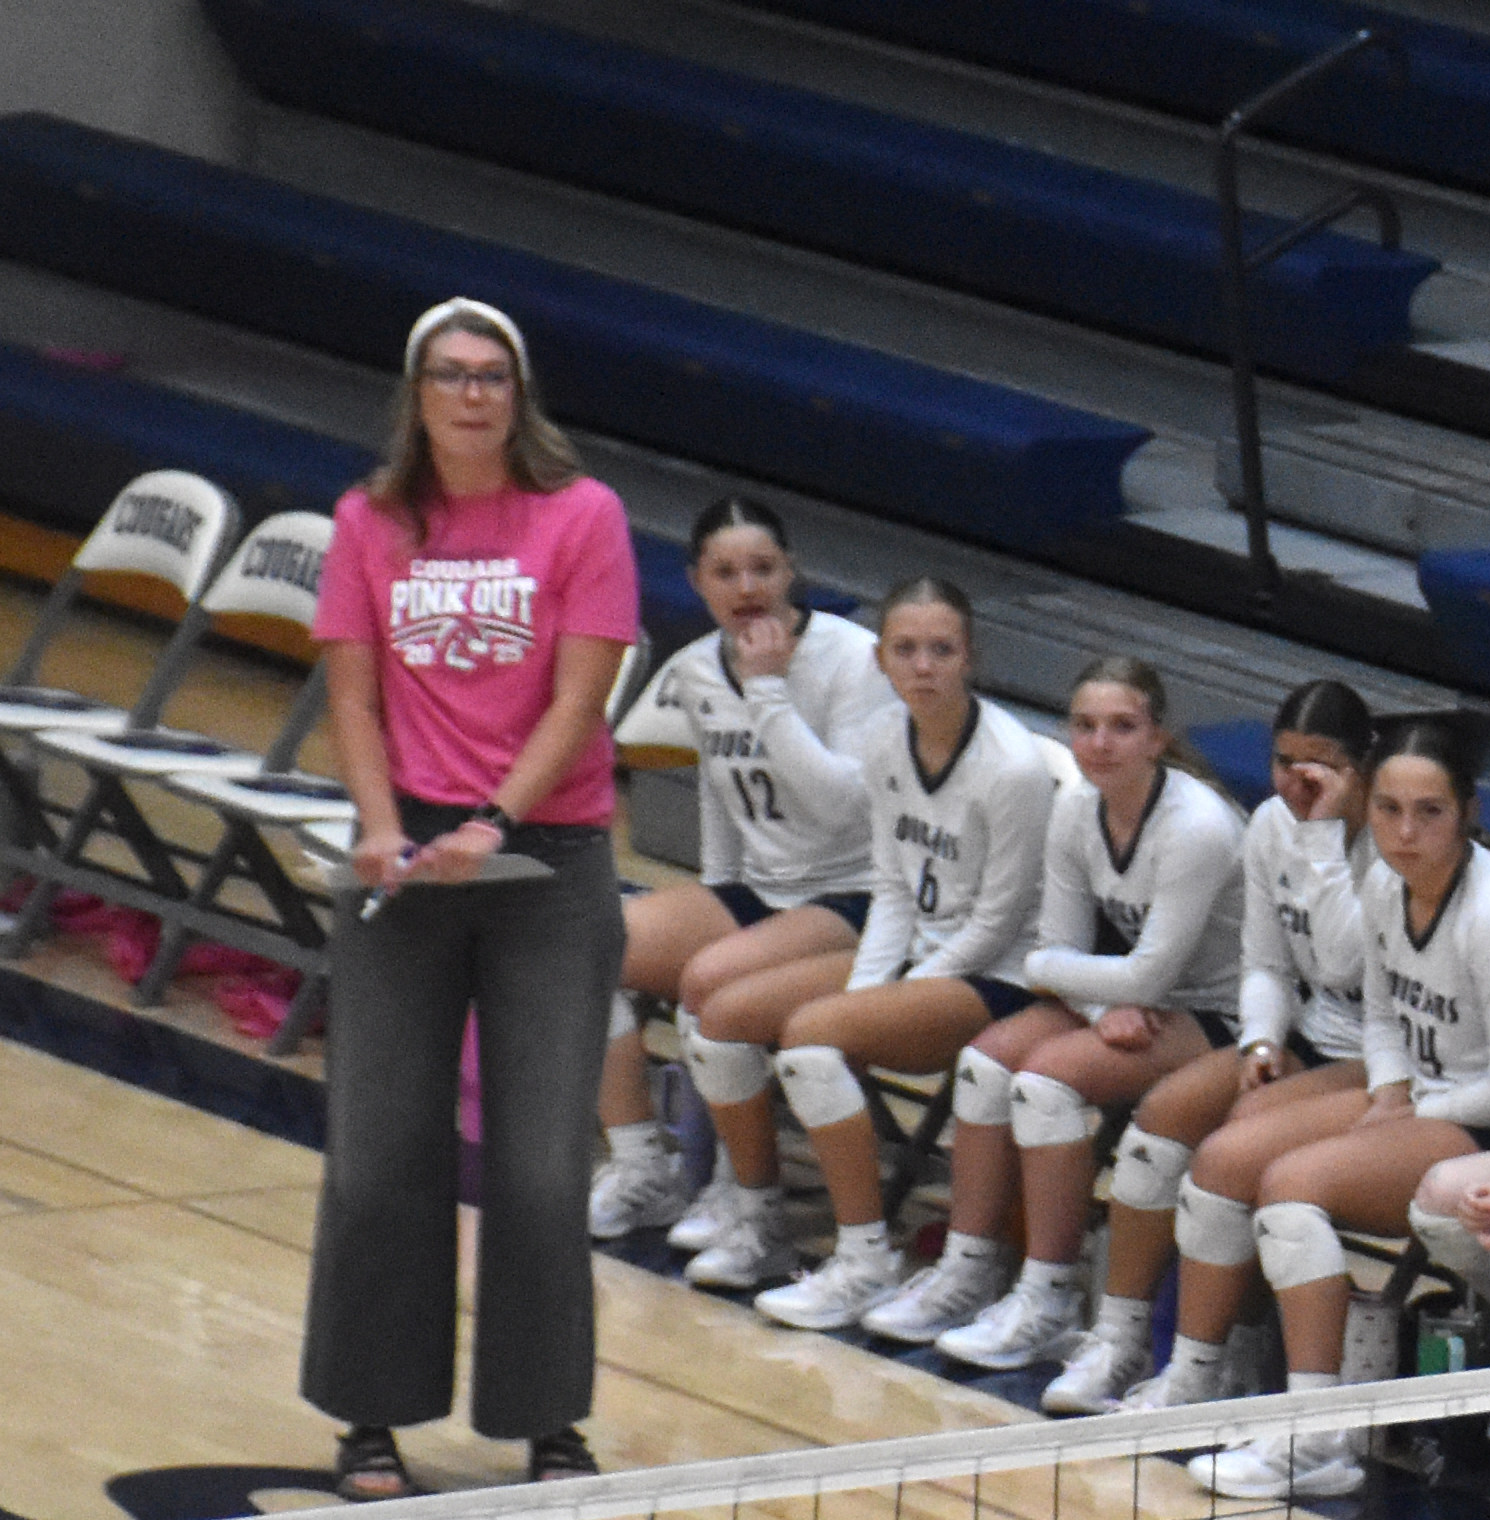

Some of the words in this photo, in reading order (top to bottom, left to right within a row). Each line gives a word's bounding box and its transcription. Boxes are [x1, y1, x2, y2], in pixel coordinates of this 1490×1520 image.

[240, 537, 323, 596] COUGA
[390, 577, 467, 627] PINK
[472, 576, 537, 625] OUT
[731, 767, 785, 822] 12
[918, 857, 938, 914] 6
